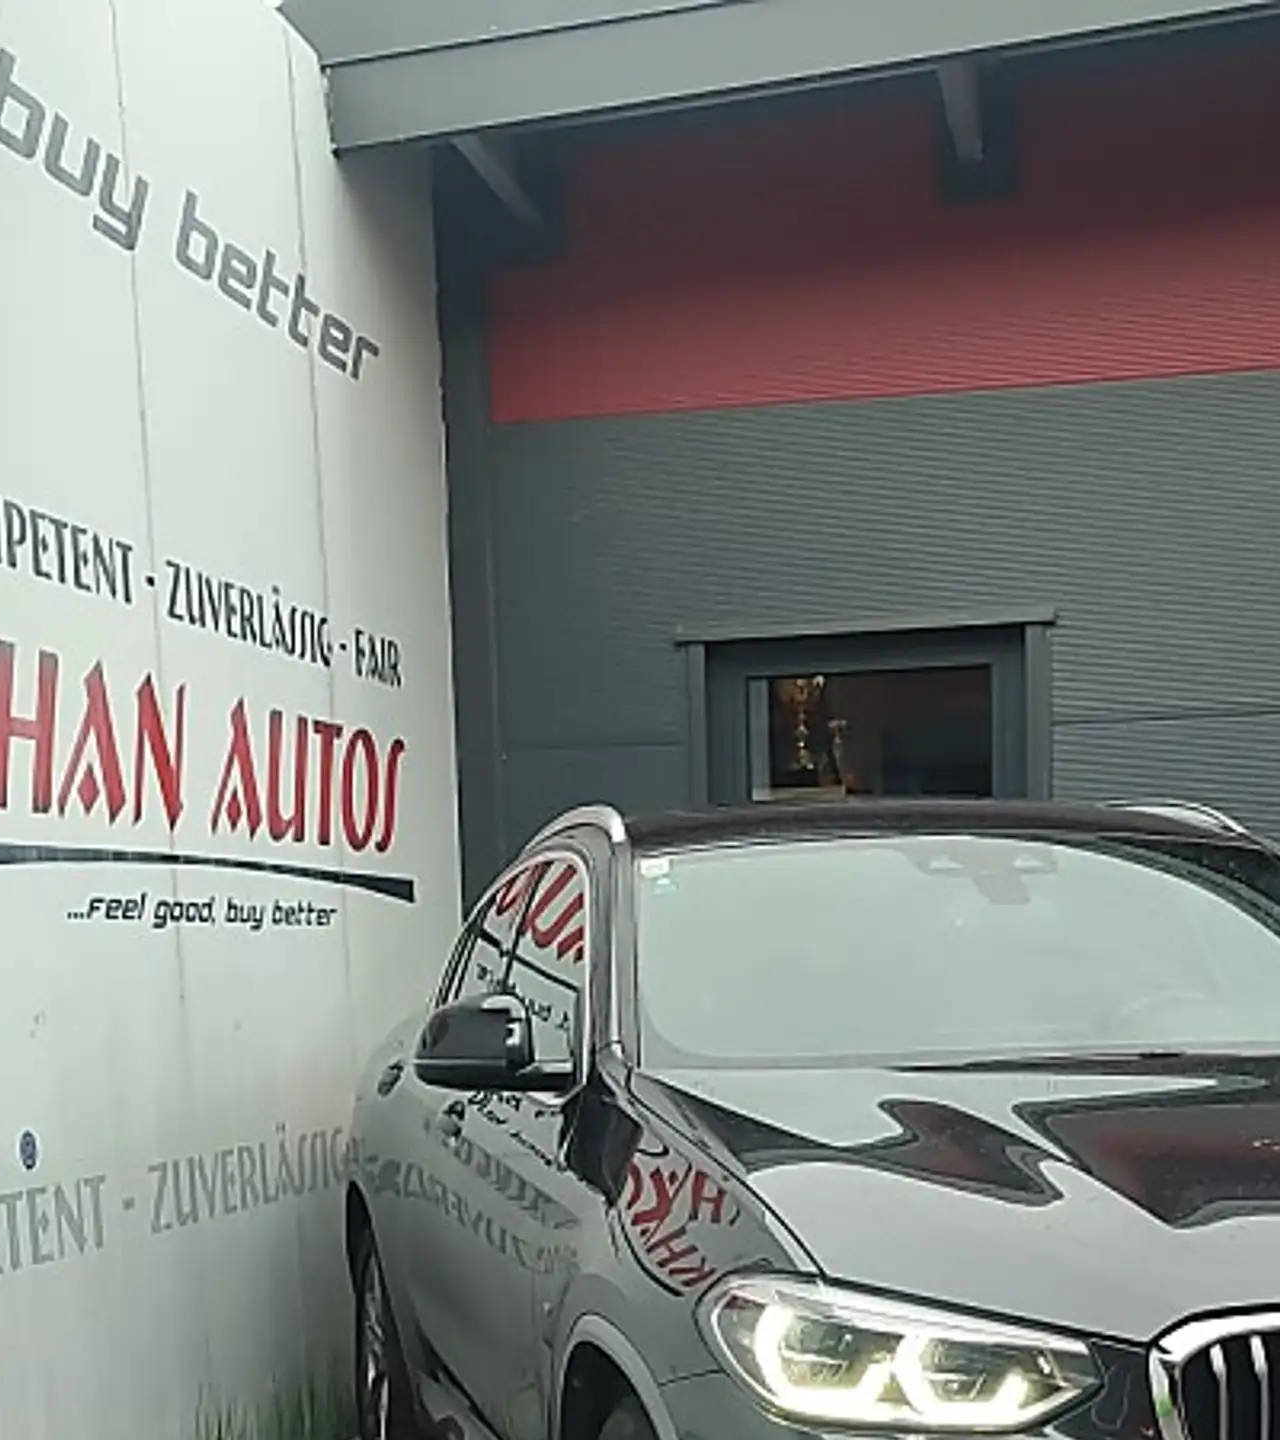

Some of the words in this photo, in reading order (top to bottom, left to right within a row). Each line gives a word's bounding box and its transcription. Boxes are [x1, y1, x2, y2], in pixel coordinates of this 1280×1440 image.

[175, 189, 381, 382] better
[165, 559, 335, 668] ZUVERLÄSSIG
[353, 627, 403, 687] FAIR
[209, 697, 406, 854] AUTOS
[224, 897, 266, 931] buy
[271, 898, 338, 927] better
